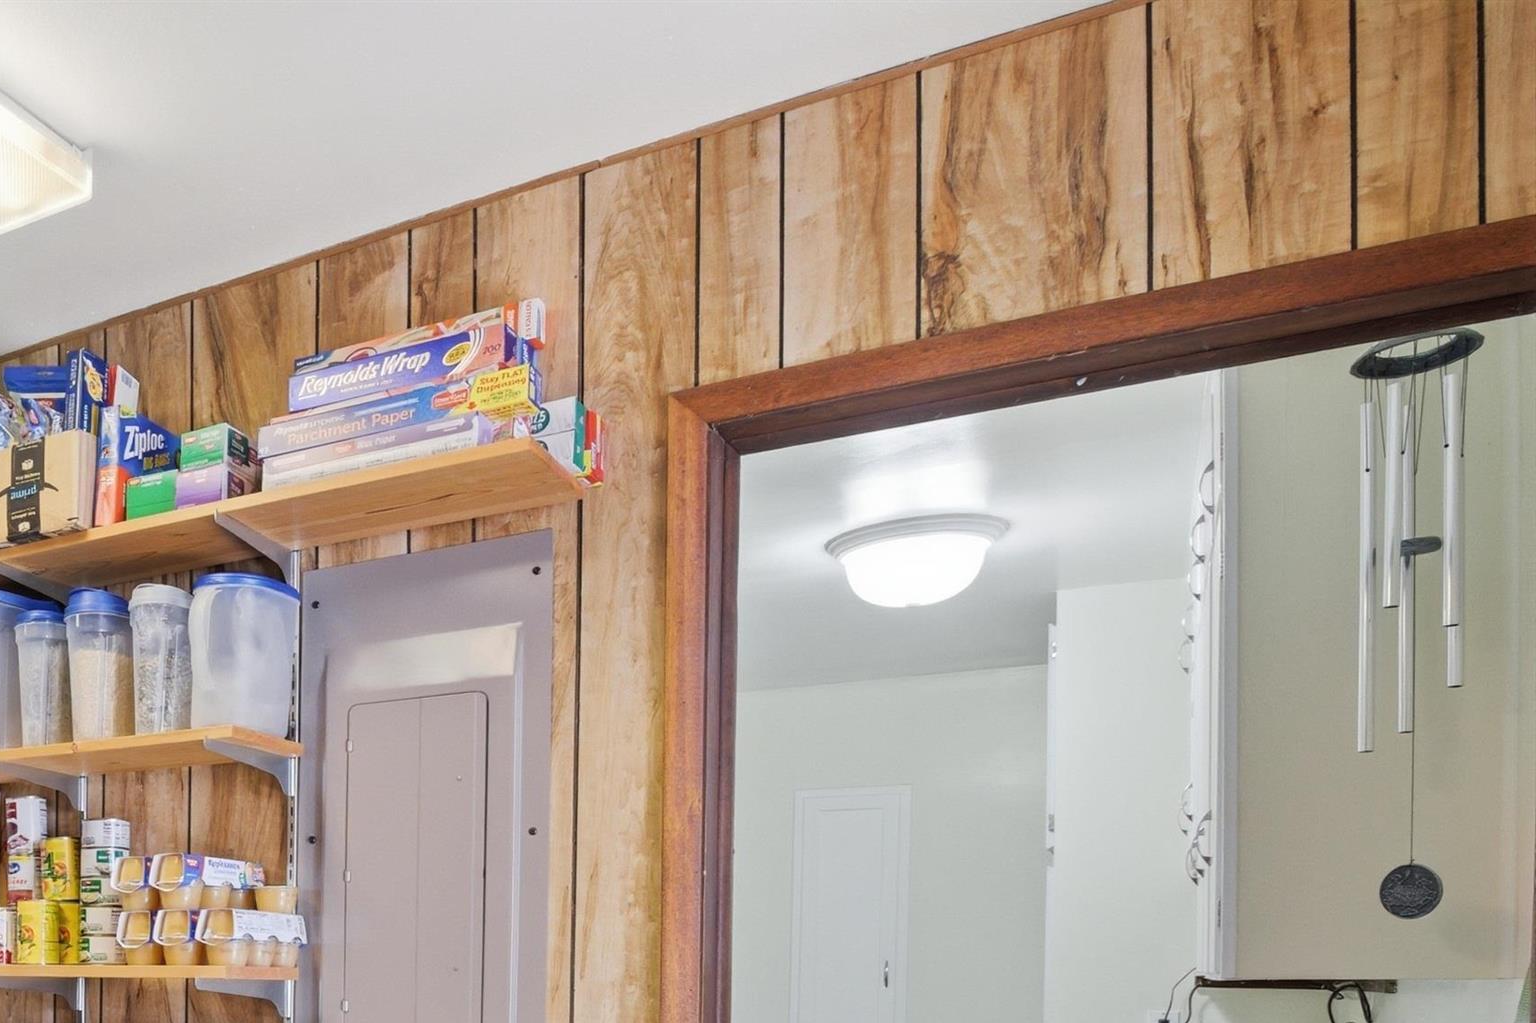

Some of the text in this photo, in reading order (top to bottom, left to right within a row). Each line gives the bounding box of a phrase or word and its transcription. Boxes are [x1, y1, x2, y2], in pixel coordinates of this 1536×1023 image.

[298, 350, 431, 400] Reynolds Wrap
[123, 425, 166, 461] Ziploc
[287, 408, 416, 446] Parchment Paper
